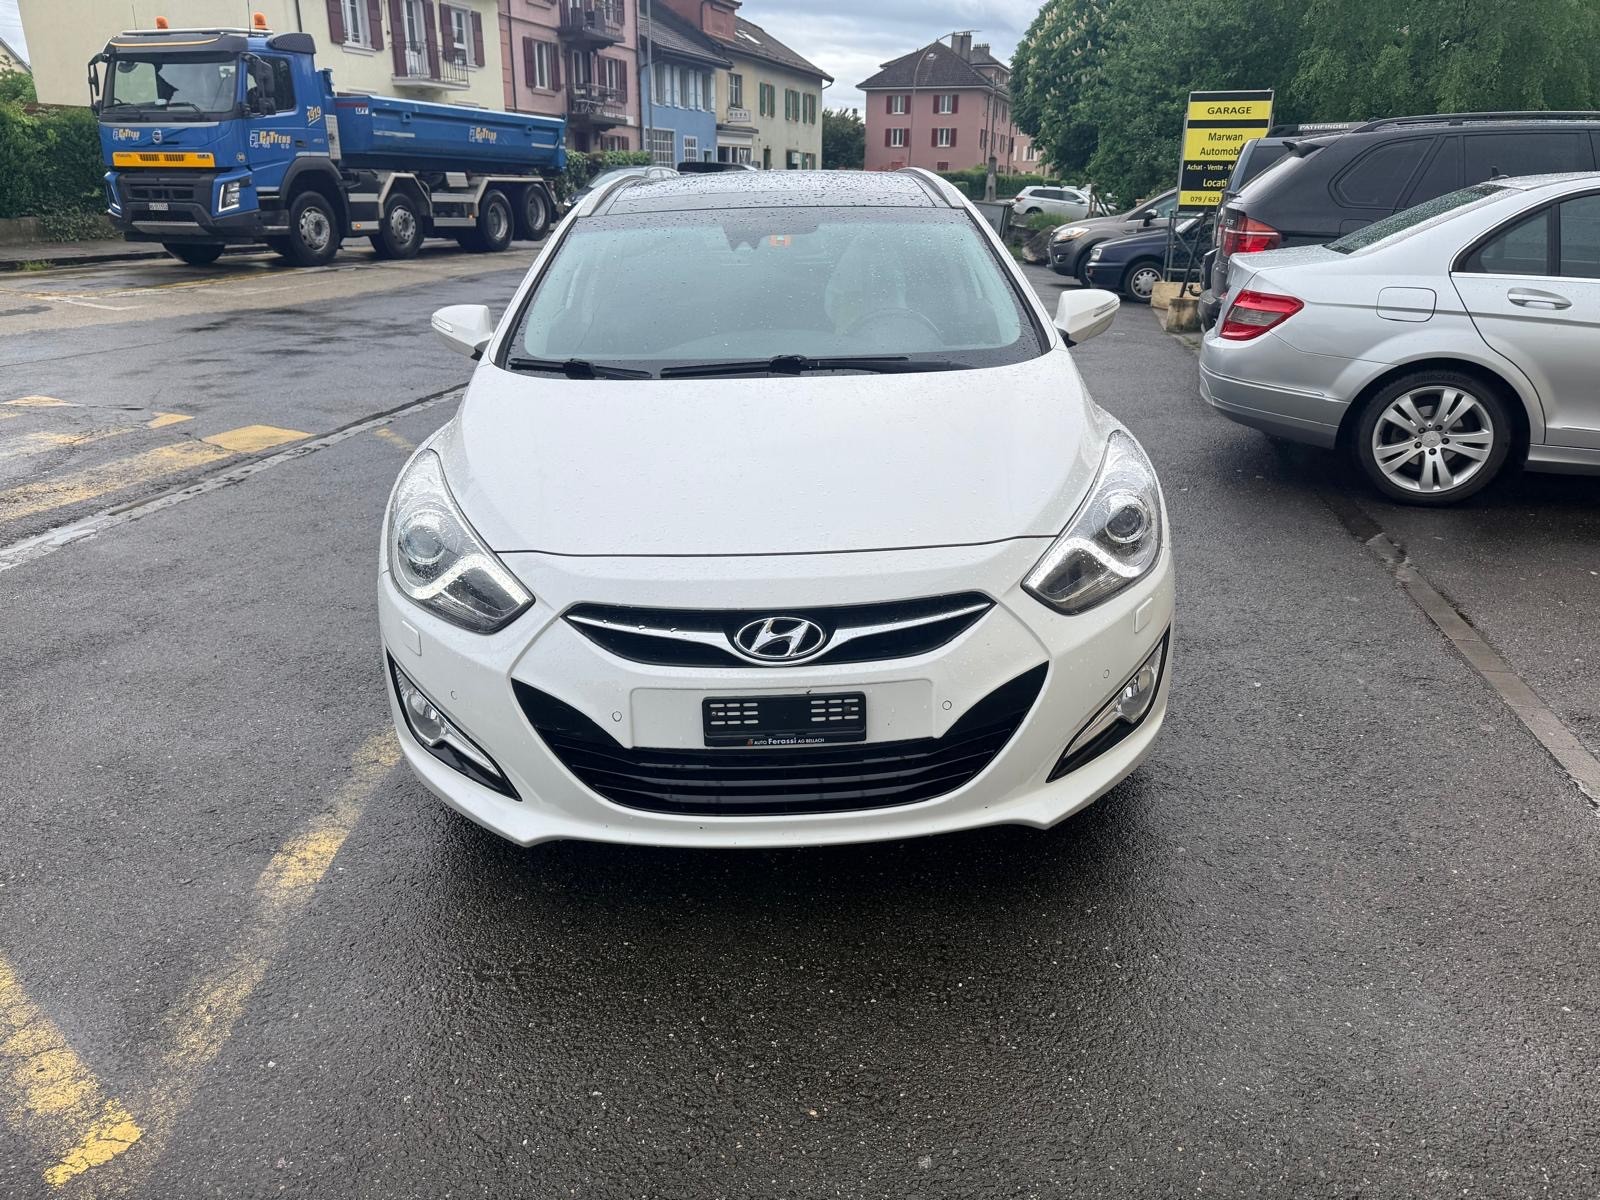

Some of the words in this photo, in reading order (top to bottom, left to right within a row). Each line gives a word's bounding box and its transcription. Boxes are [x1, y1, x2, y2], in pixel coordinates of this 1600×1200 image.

[1207, 106, 1252, 115] GARAGE
[1208, 132, 1243, 141] Marwan
[1187, 163, 1203, 171] Achat
[1207, 163, 1223, 171] Vente
[768, 737, 797, 745] Ferassi
